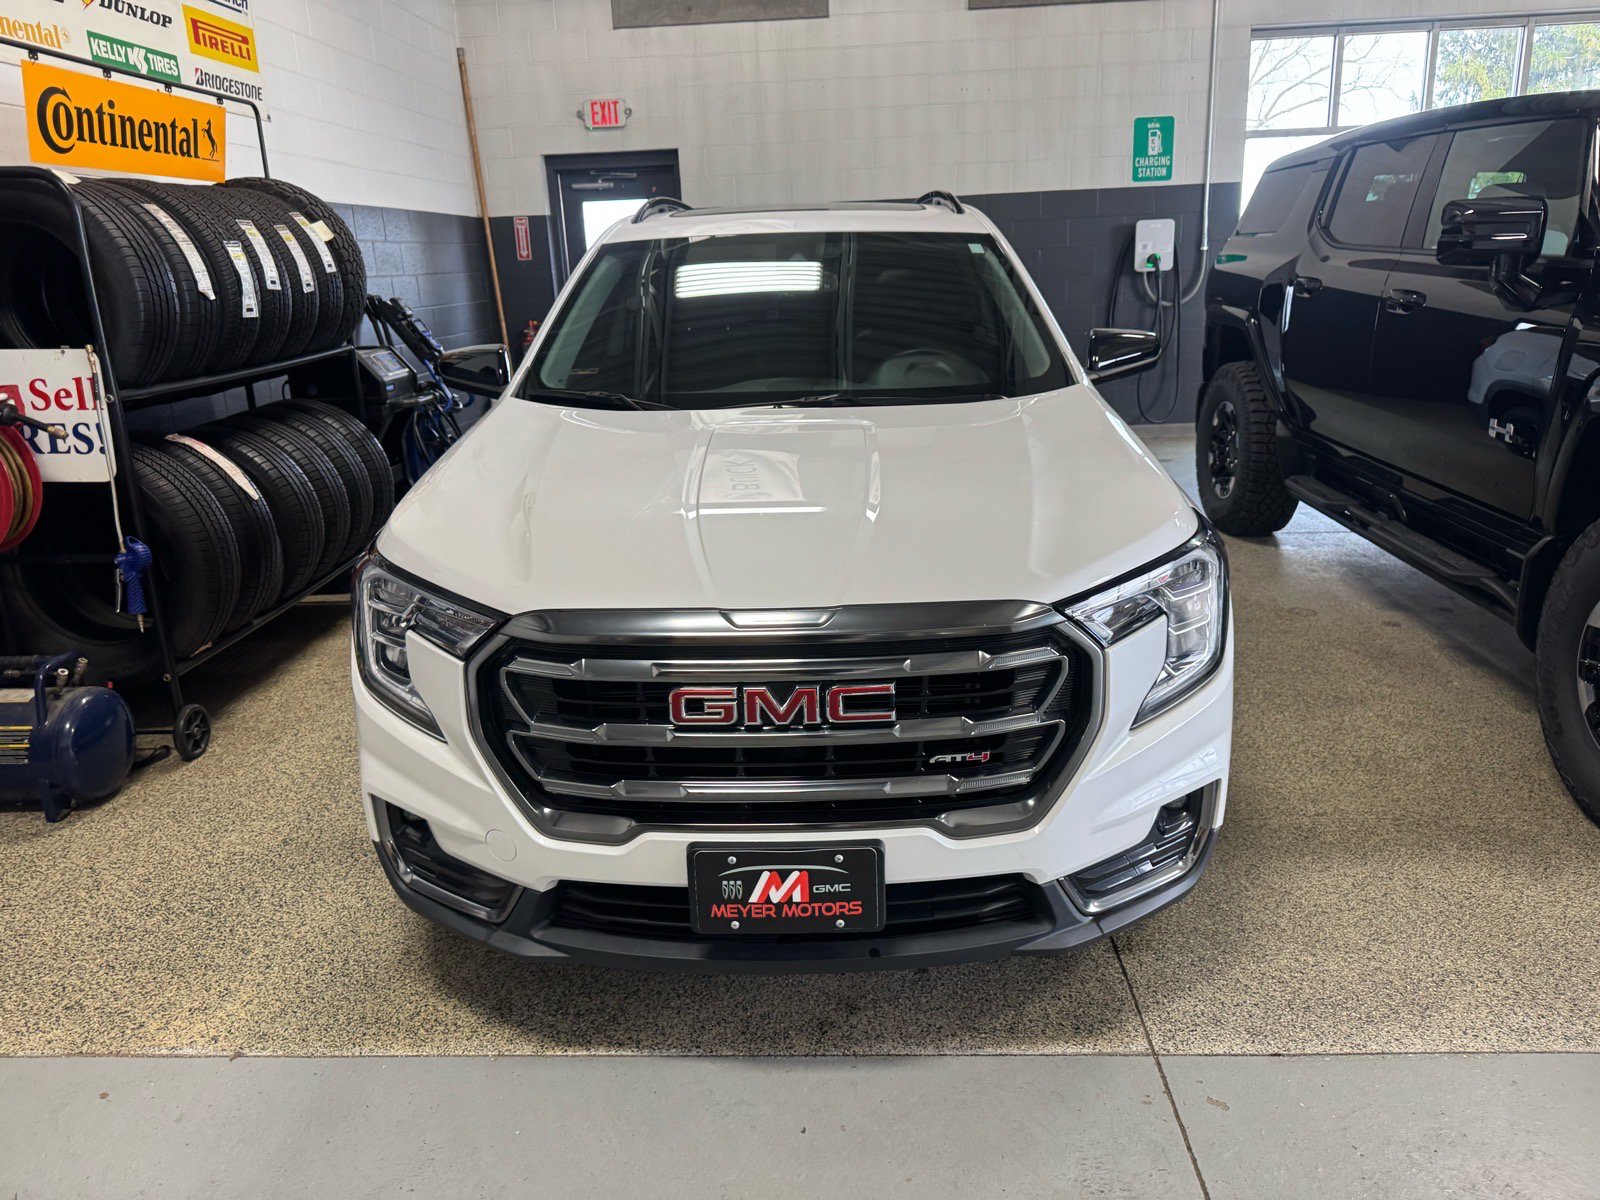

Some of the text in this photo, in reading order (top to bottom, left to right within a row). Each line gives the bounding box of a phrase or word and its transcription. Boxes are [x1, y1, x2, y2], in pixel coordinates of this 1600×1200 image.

[99, 0, 173, 28] DUNLOP
[190, 17, 252, 61] PIRELLI
[90, 38, 128, 62] KELLY
[146, 53, 178, 77] TIRES
[195, 67, 263, 101] BRIDGESTONE
[36, 86, 200, 159] Continental
[590, 100, 619, 126] EXIT
[1135, 156, 1170, 167] CHARGING
[1138, 167, 1166, 177] STATION
[28, 376, 104, 411] Sell
[669, 681, 897, 726] GMC
[929, 750, 991, 763] AT4
[813, 883, 851, 893] GMC
[710, 900, 863, 918] MEYER MOTORS
